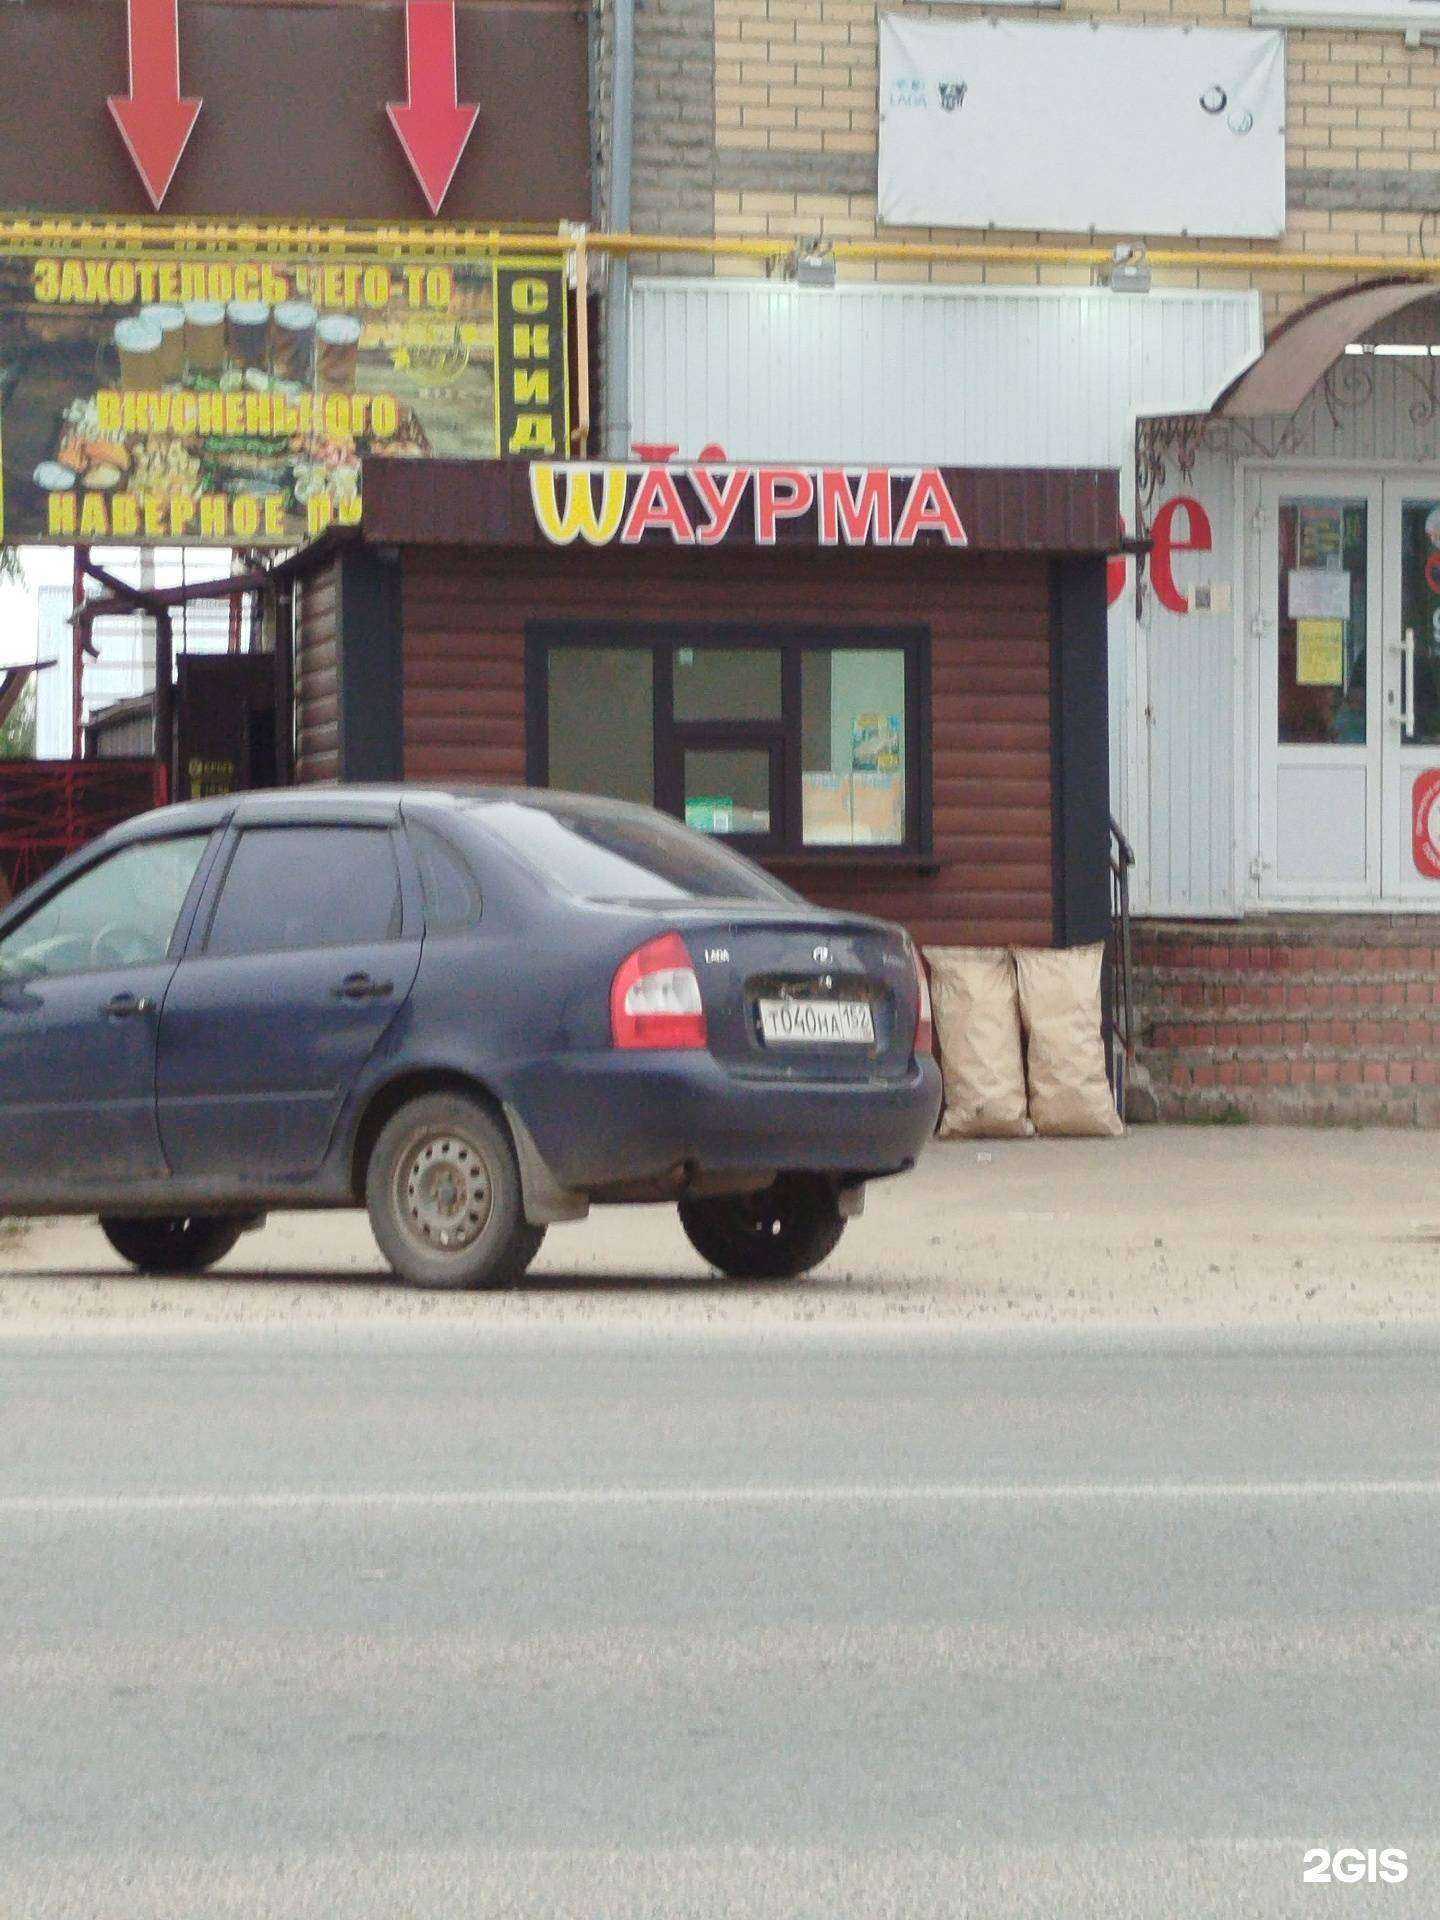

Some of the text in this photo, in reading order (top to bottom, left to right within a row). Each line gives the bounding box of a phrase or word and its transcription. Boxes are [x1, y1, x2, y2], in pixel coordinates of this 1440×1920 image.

[33, 258, 290, 304] ЗАХОТЕЛОСЬ
[508, 277, 556, 455] СКИД
[48, 491, 290, 537] НАВЕРНОЕ
